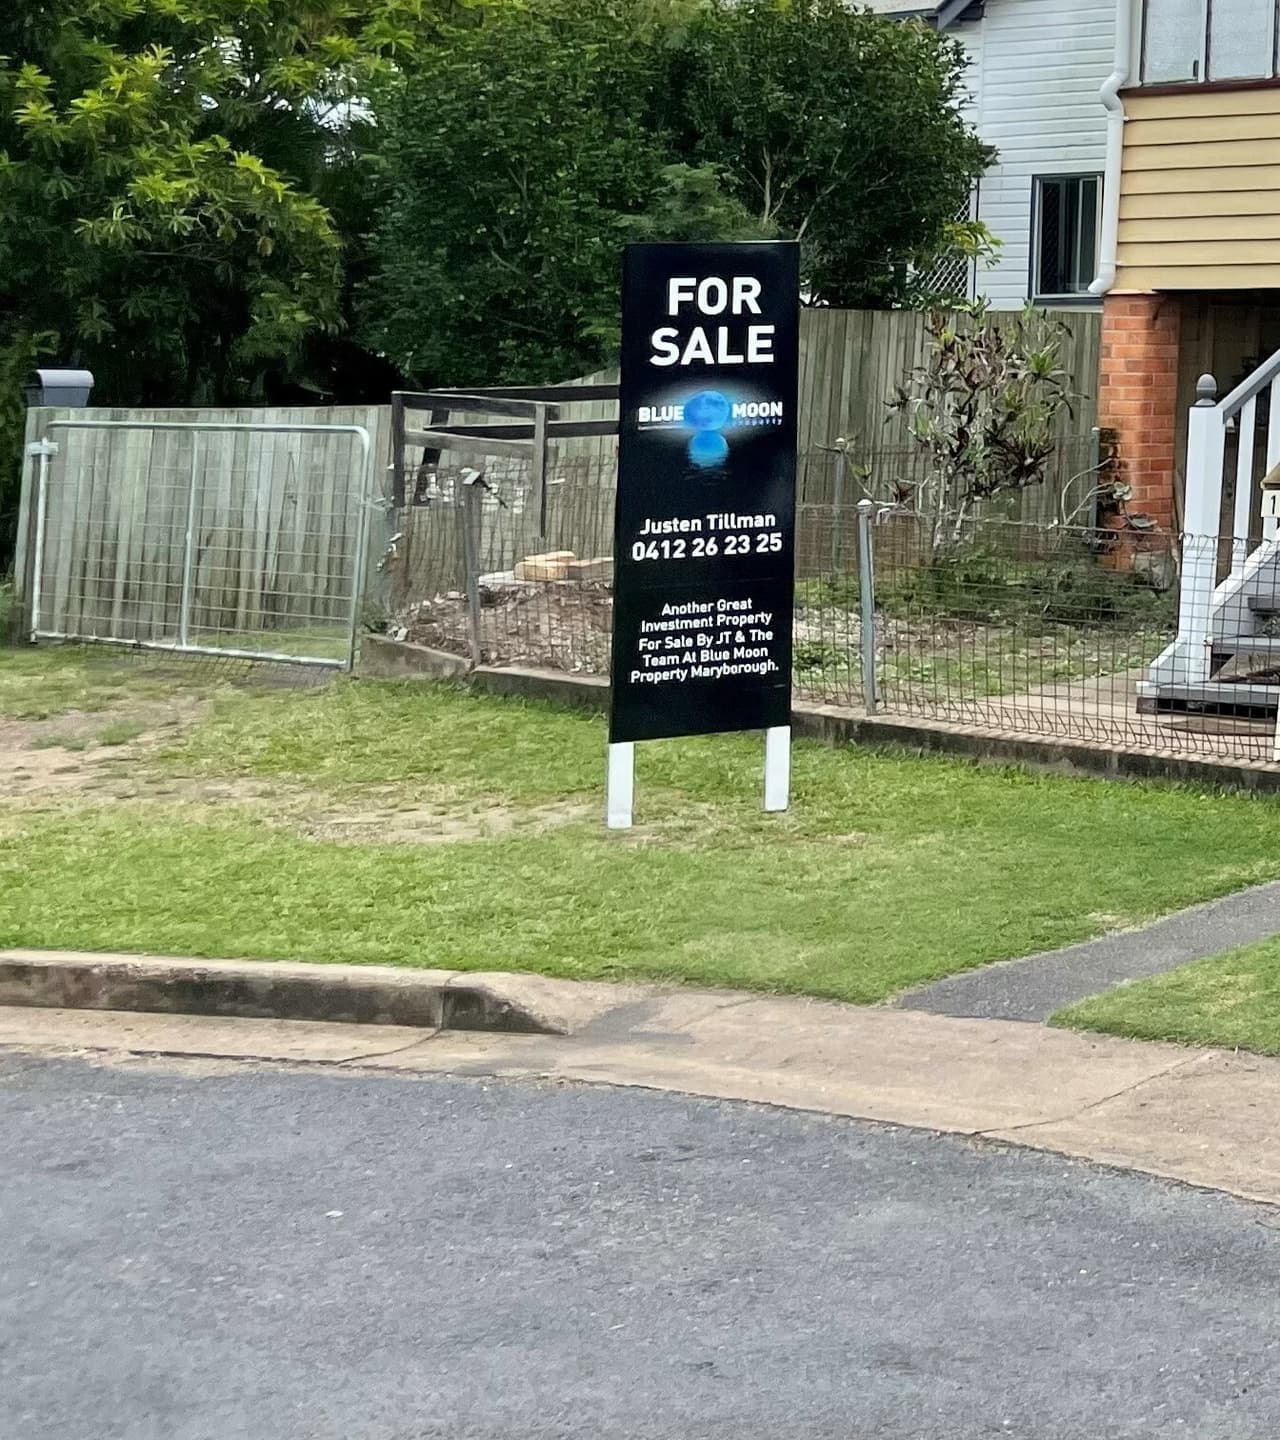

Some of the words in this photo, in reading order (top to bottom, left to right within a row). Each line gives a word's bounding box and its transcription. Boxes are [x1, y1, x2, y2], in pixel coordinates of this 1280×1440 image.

[668, 276, 762, 316] FOR
[649, 325, 775, 366] SALE
[638, 406, 684, 422] BLUE
[732, 401, 783, 418] MOON
[732, 417, 782, 427] operty
[640, 518, 702, 535] Justen
[706, 513, 776, 530] Tillman
[632, 539, 686, 561] 0412
[691, 536, 719, 557] 26
[723, 534, 751, 555] 23
[755, 532, 782, 553] 25
[661, 601, 714, 616] Another
[716, 597, 753, 612] Great
[641, 616, 714, 633] Investment
[716, 611, 773, 627] Property
[638, 637, 662, 651] For
[664, 635, 693, 649] Sale
[696, 633, 714, 648] By
[715, 631, 732, 645] JT
[734, 630, 746, 643] &
[749, 628, 774, 642] The
[642, 654, 680, 667] Team
[681, 651, 697, 664] At
[700, 649, 730, 662] Blue
[733, 646, 769, 660] Moon
[630, 670, 688, 685] Property
[690, 659, 779, 679] Maryborough.
